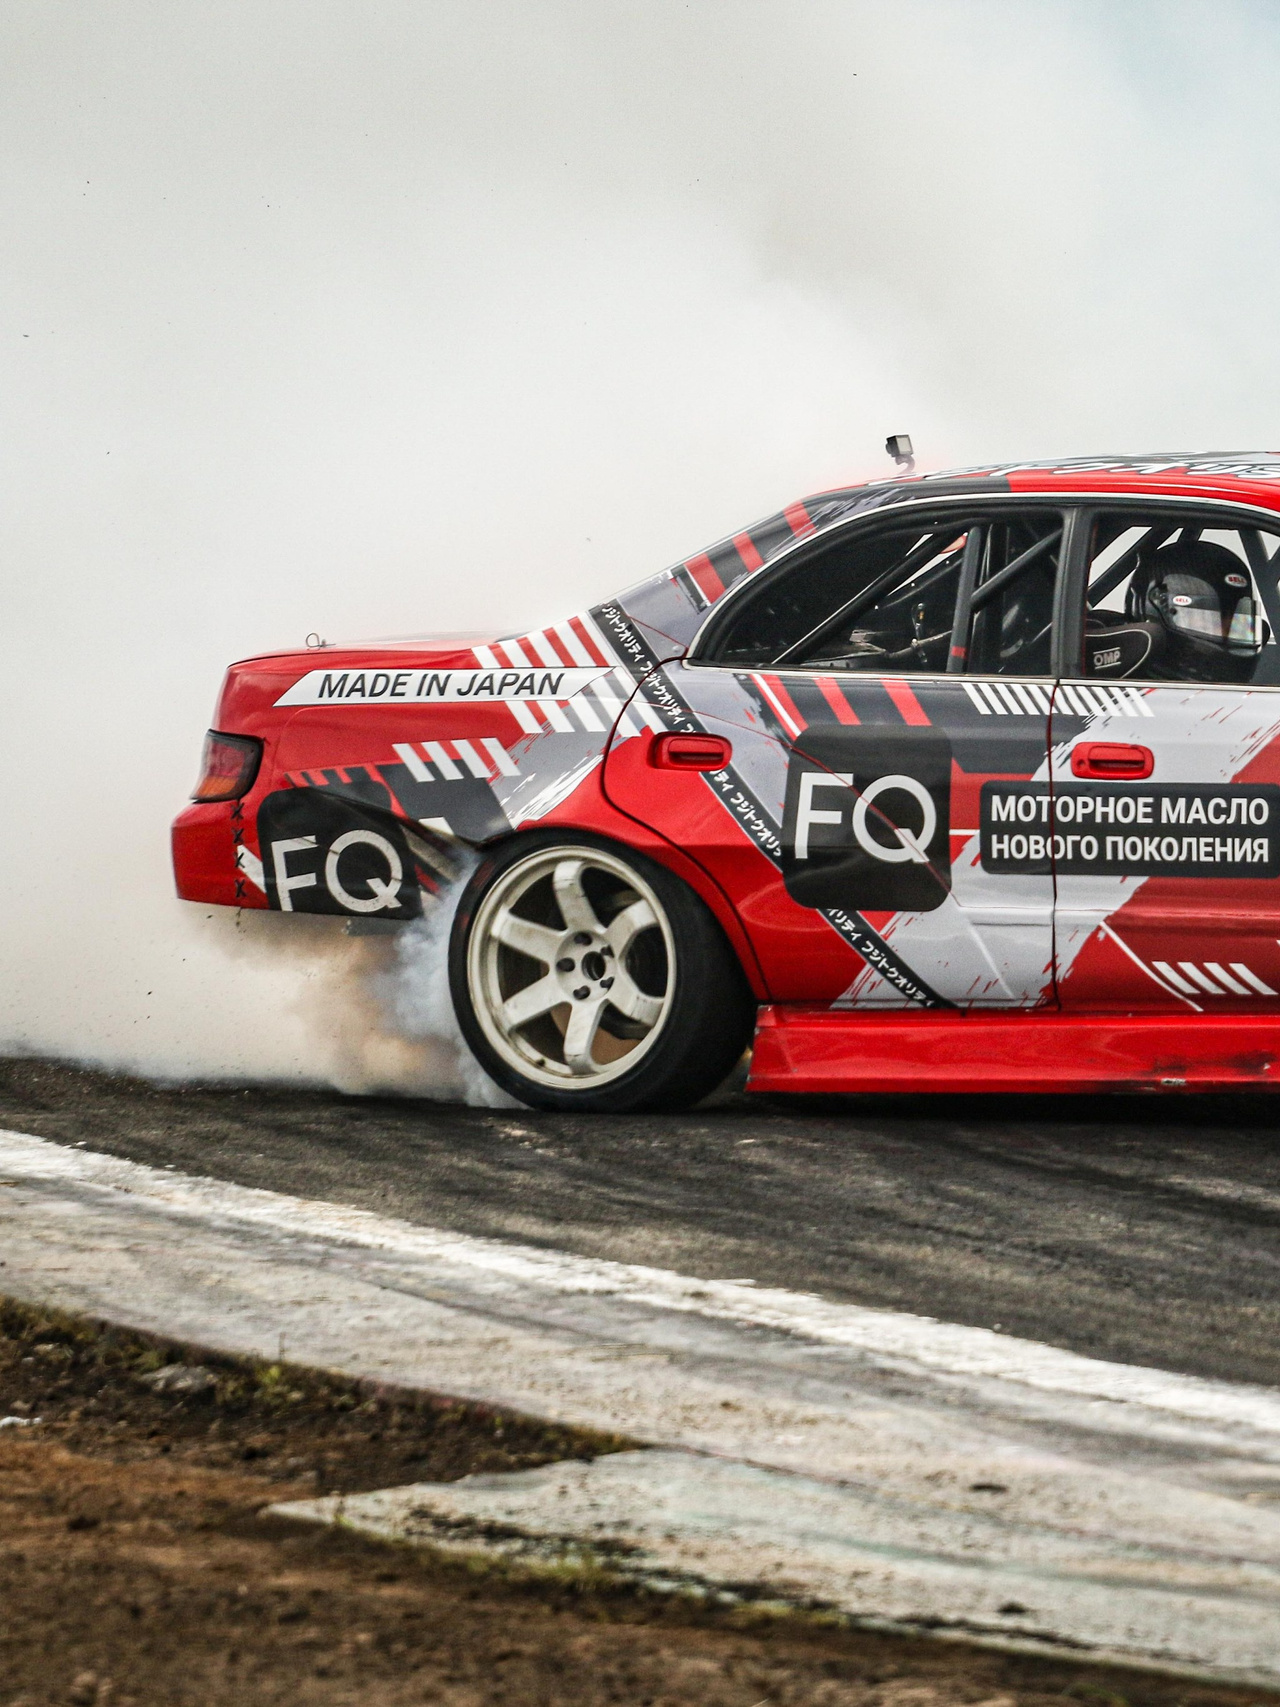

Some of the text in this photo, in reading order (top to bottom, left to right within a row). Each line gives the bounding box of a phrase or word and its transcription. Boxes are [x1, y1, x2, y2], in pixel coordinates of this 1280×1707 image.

[1227, 575, 1246, 585] BELL
[1093, 651, 1121, 666] OMP
[318, 672, 565, 698] MADE IN JAPAN
[795, 772, 937, 864] FQ
[991, 795, 1269, 826] МОТОРНОЕ МАСЛО
[991, 834, 1269, 862] НОВОГО ПОКОЛЕНИЯ
[271, 829, 403, 913] FQ
